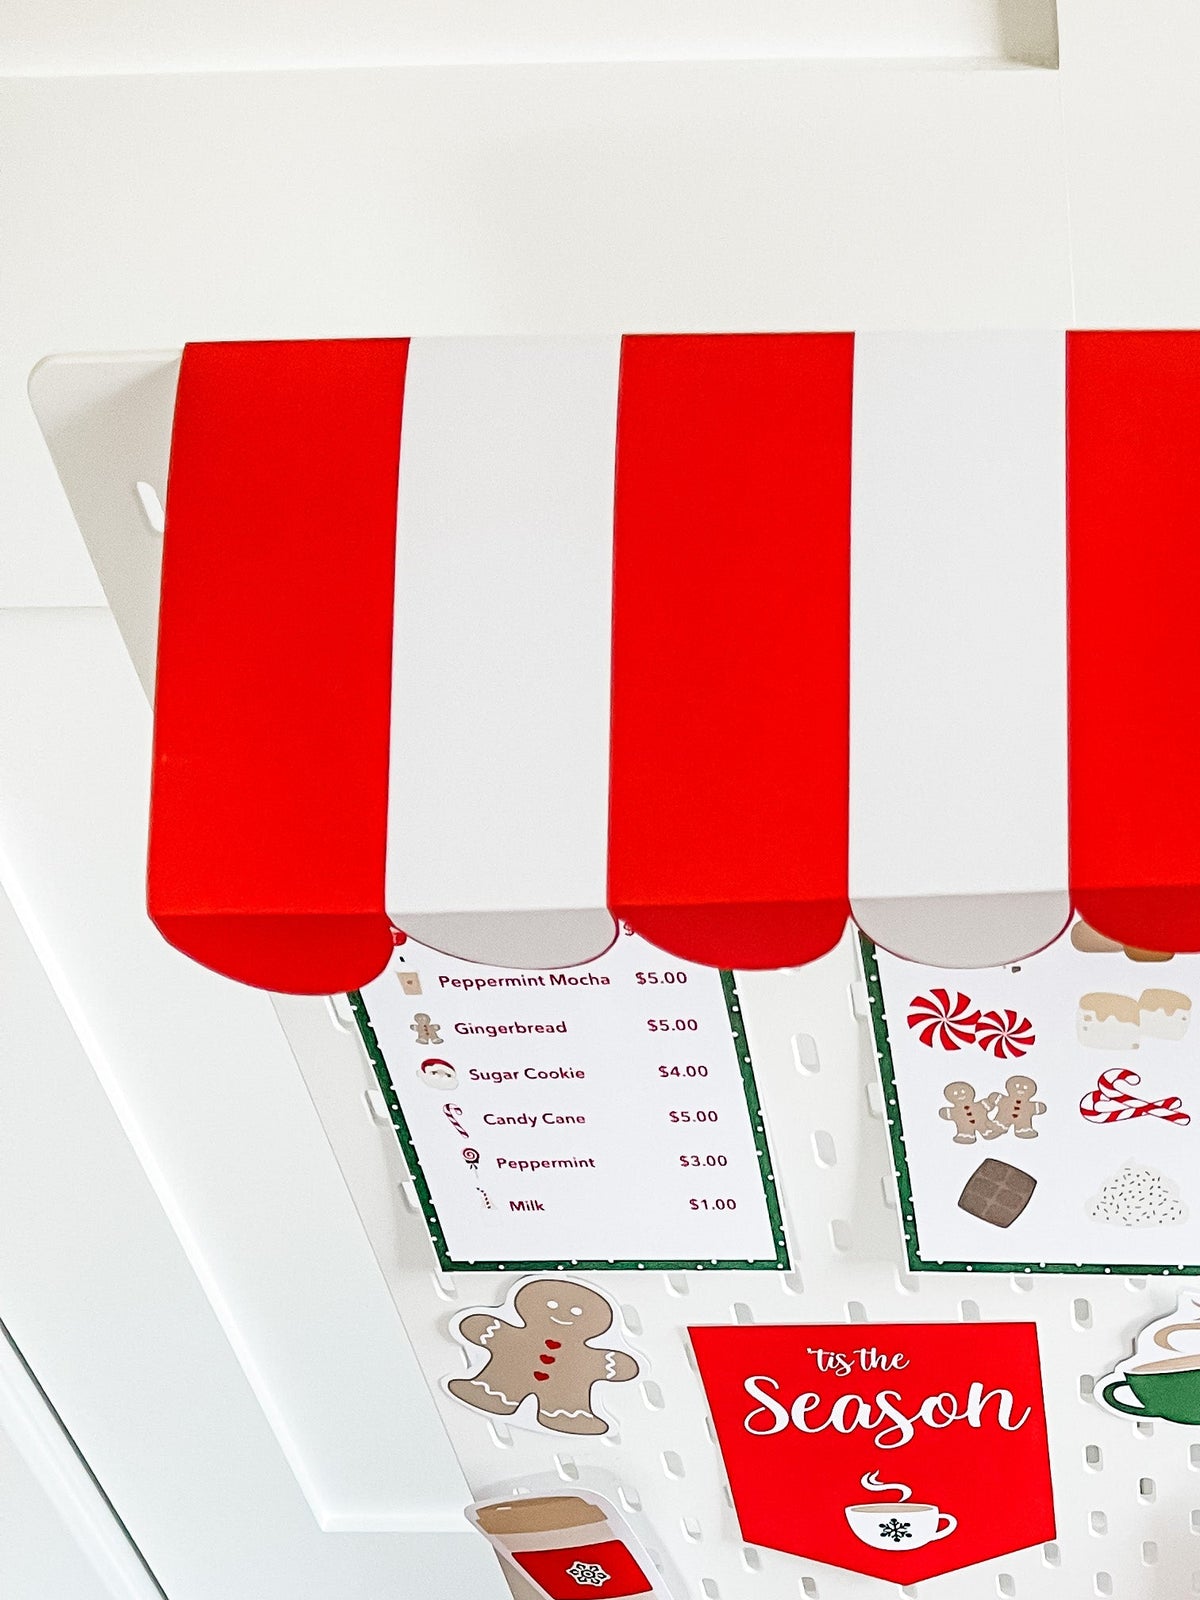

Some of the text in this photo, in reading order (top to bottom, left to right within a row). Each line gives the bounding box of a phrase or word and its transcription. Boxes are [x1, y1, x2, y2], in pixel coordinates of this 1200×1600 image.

[438, 971, 688, 992] Peppermint Mocha $5.00
[454, 1018, 698, 1038] Gingerbread $5.00
[468, 1065, 709, 1084] Sugar Cookie $4.00
[483, 1110, 719, 1128] Candy Cane $5.00
[496, 1154, 728, 1173] Peppermint $3.00
[509, 1198, 737, 1212] Milk $1.00
[806, 1346, 910, 1377] 'tis the
[744, 1375, 1032, 1450] Season
